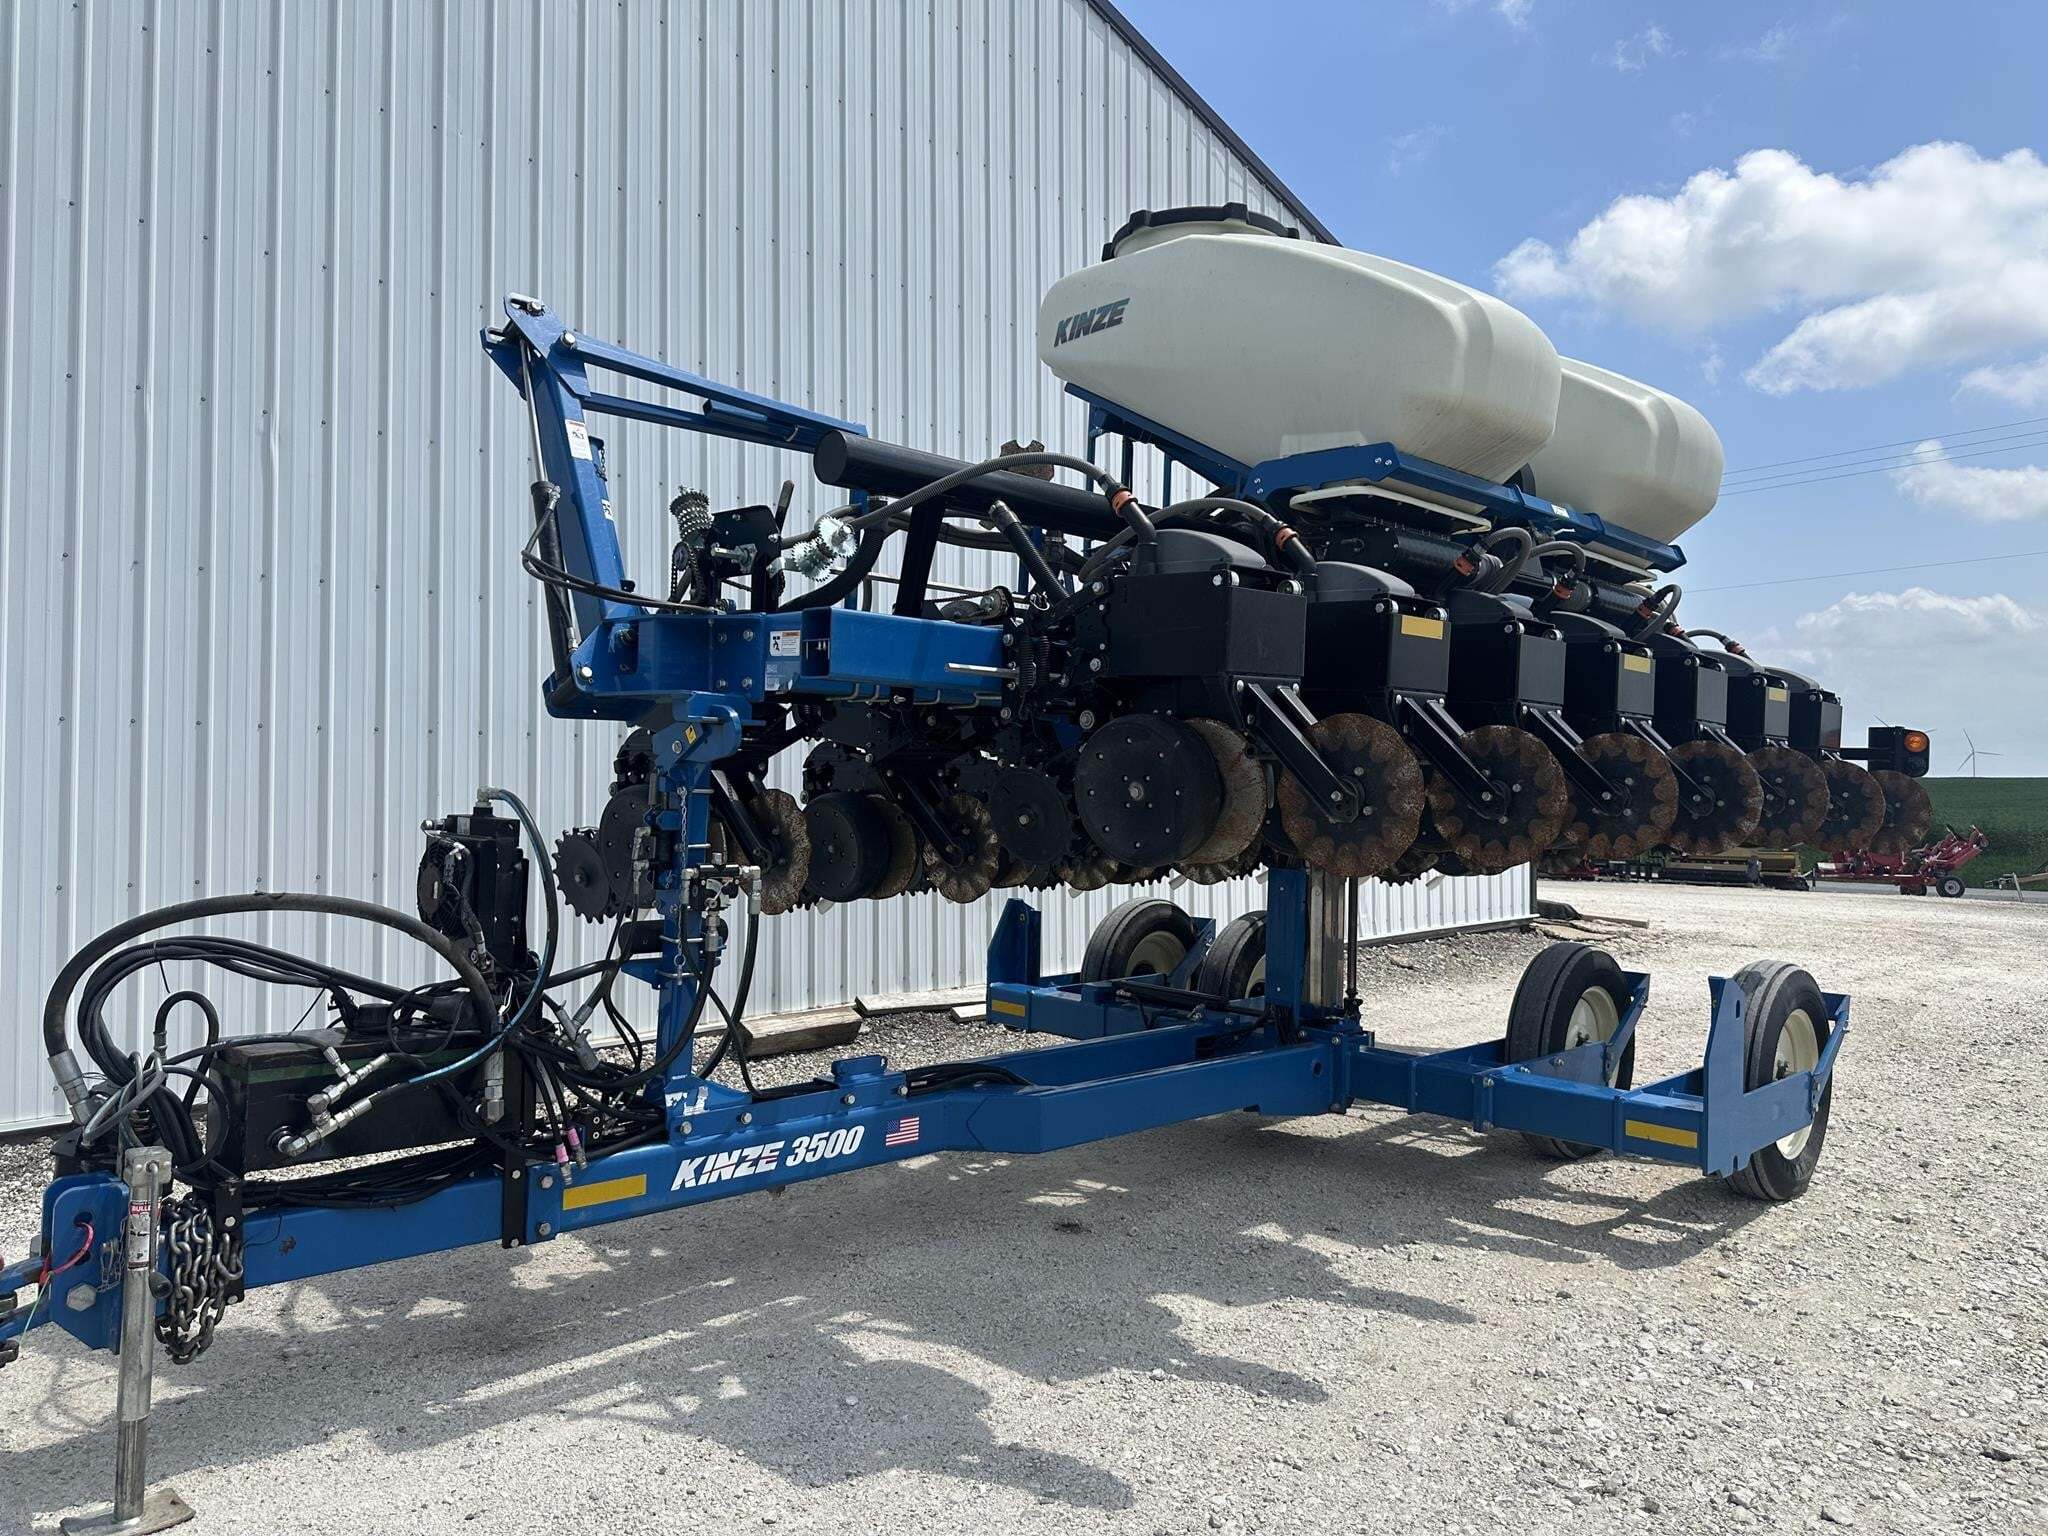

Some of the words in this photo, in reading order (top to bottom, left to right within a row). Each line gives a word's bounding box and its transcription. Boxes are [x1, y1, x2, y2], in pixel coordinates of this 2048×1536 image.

[1054, 298, 1130, 347] KINZE
[670, 1140, 785, 1191] KINZE
[785, 1125, 865, 1167] 3500
